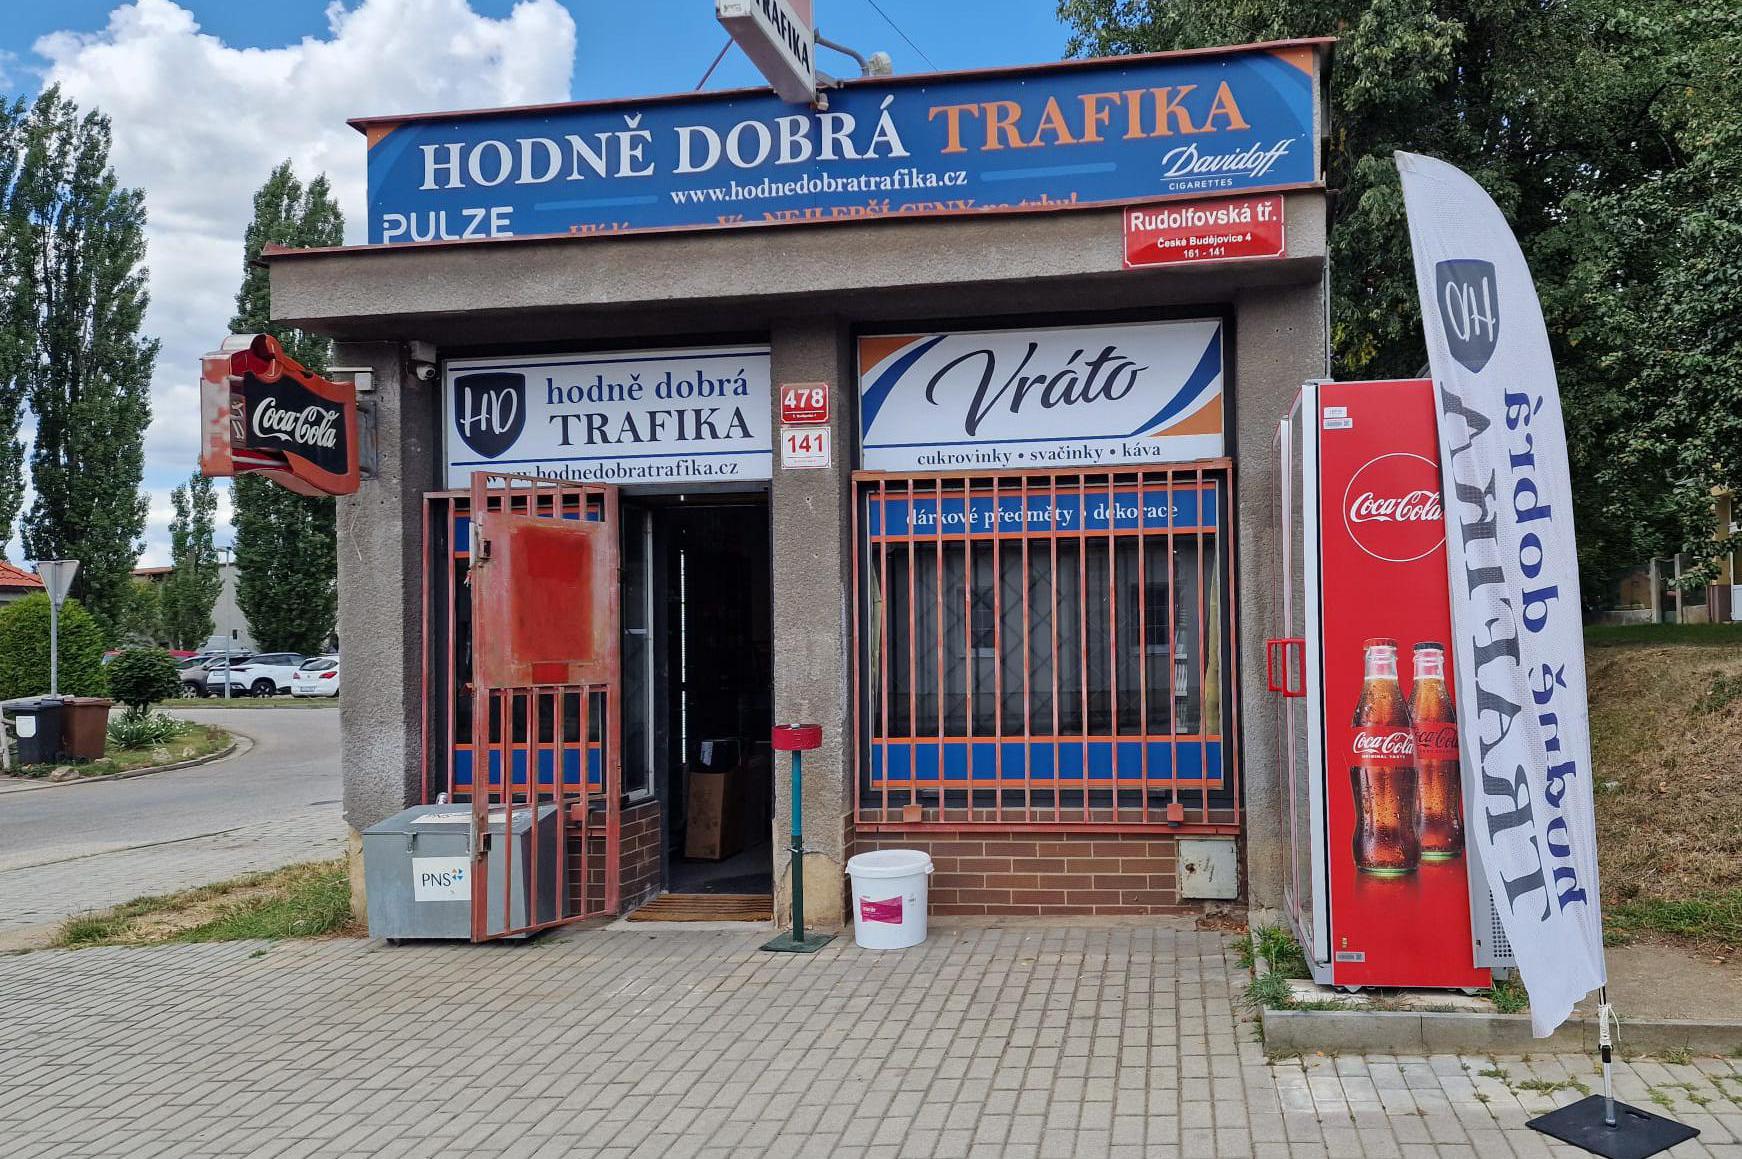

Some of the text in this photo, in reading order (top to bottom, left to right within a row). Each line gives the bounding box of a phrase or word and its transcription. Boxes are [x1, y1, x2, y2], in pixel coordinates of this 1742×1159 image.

[755, 0, 811, 74] RAFIKA
[418, 80, 1251, 191] HODNĚ DOBRÁ TRAFIKA
[1161, 138, 1296, 177] Davidoff
[670, 169, 968, 205] www.hodnedobratrafika.cz
[1168, 178, 1233, 190] CIGARETTES
[382, 205, 514, 245] PULZE
[1130, 201, 1277, 232] Rudolfovská tř.
[1157, 232, 1252, 249] České Budějovice 4
[1183, 249, 1200, 259] 161
[1209, 247, 1225, 257] 141
[546, 368, 750, 405] hodně dobrá
[784, 388, 824, 409] 478
[925, 341, 1150, 437] Vráto
[252, 397, 340, 448] Coca-Cola
[459, 386, 519, 439] HD
[548, 406, 756, 446] TRAFIKA
[787, 433, 823, 453] 141
[917, 441, 1161, 467] cukrovinky svačinky káva
[486, 459, 740, 485] hodnedobratrafika.cz
[984, 505, 1074, 529] předměty
[1350, 490, 1442, 523] Coca-Cola
[1352, 731, 1414, 754] Coca-Cola
[421, 872, 452, 887] PNS
